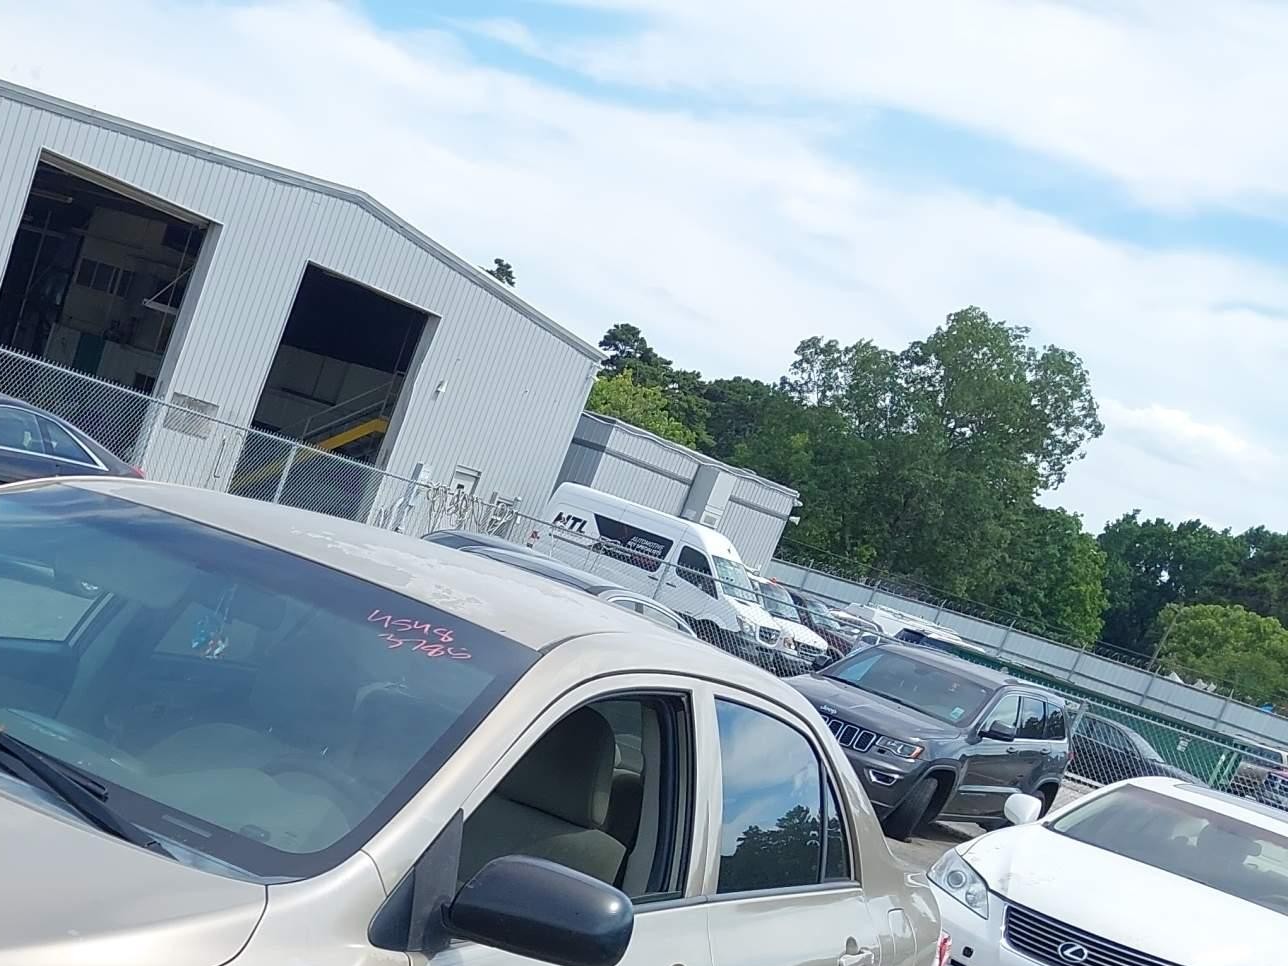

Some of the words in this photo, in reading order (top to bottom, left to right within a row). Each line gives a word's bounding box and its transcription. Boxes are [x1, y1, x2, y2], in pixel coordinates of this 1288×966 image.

[367, 609, 454, 642] 4548
[376, 633, 472, 660] 3785
[819, 704, 837, 715] Jeep
